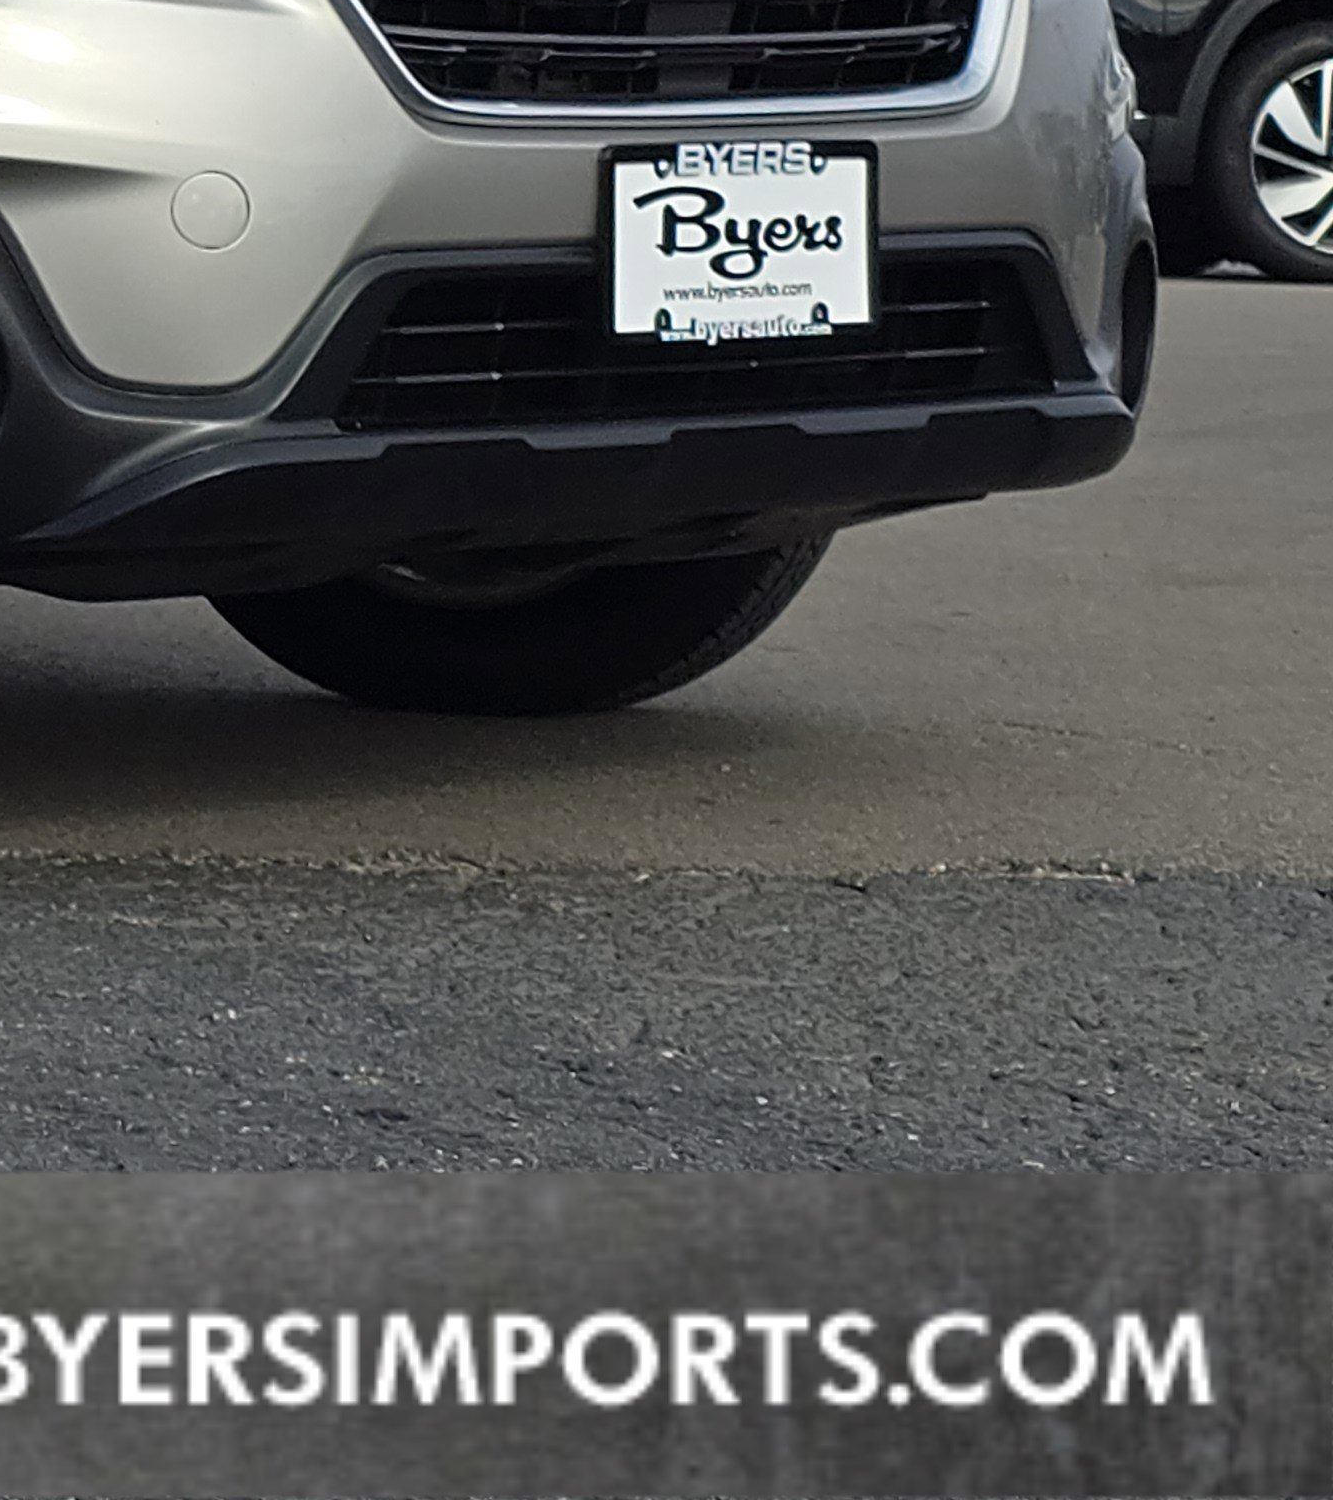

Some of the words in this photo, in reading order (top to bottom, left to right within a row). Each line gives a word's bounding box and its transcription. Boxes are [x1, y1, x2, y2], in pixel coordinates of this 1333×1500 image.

[675, 141, 813, 176] BYERS
[633, 186, 843, 281] Byers
[662, 281, 813, 303] www.byersauto.com
